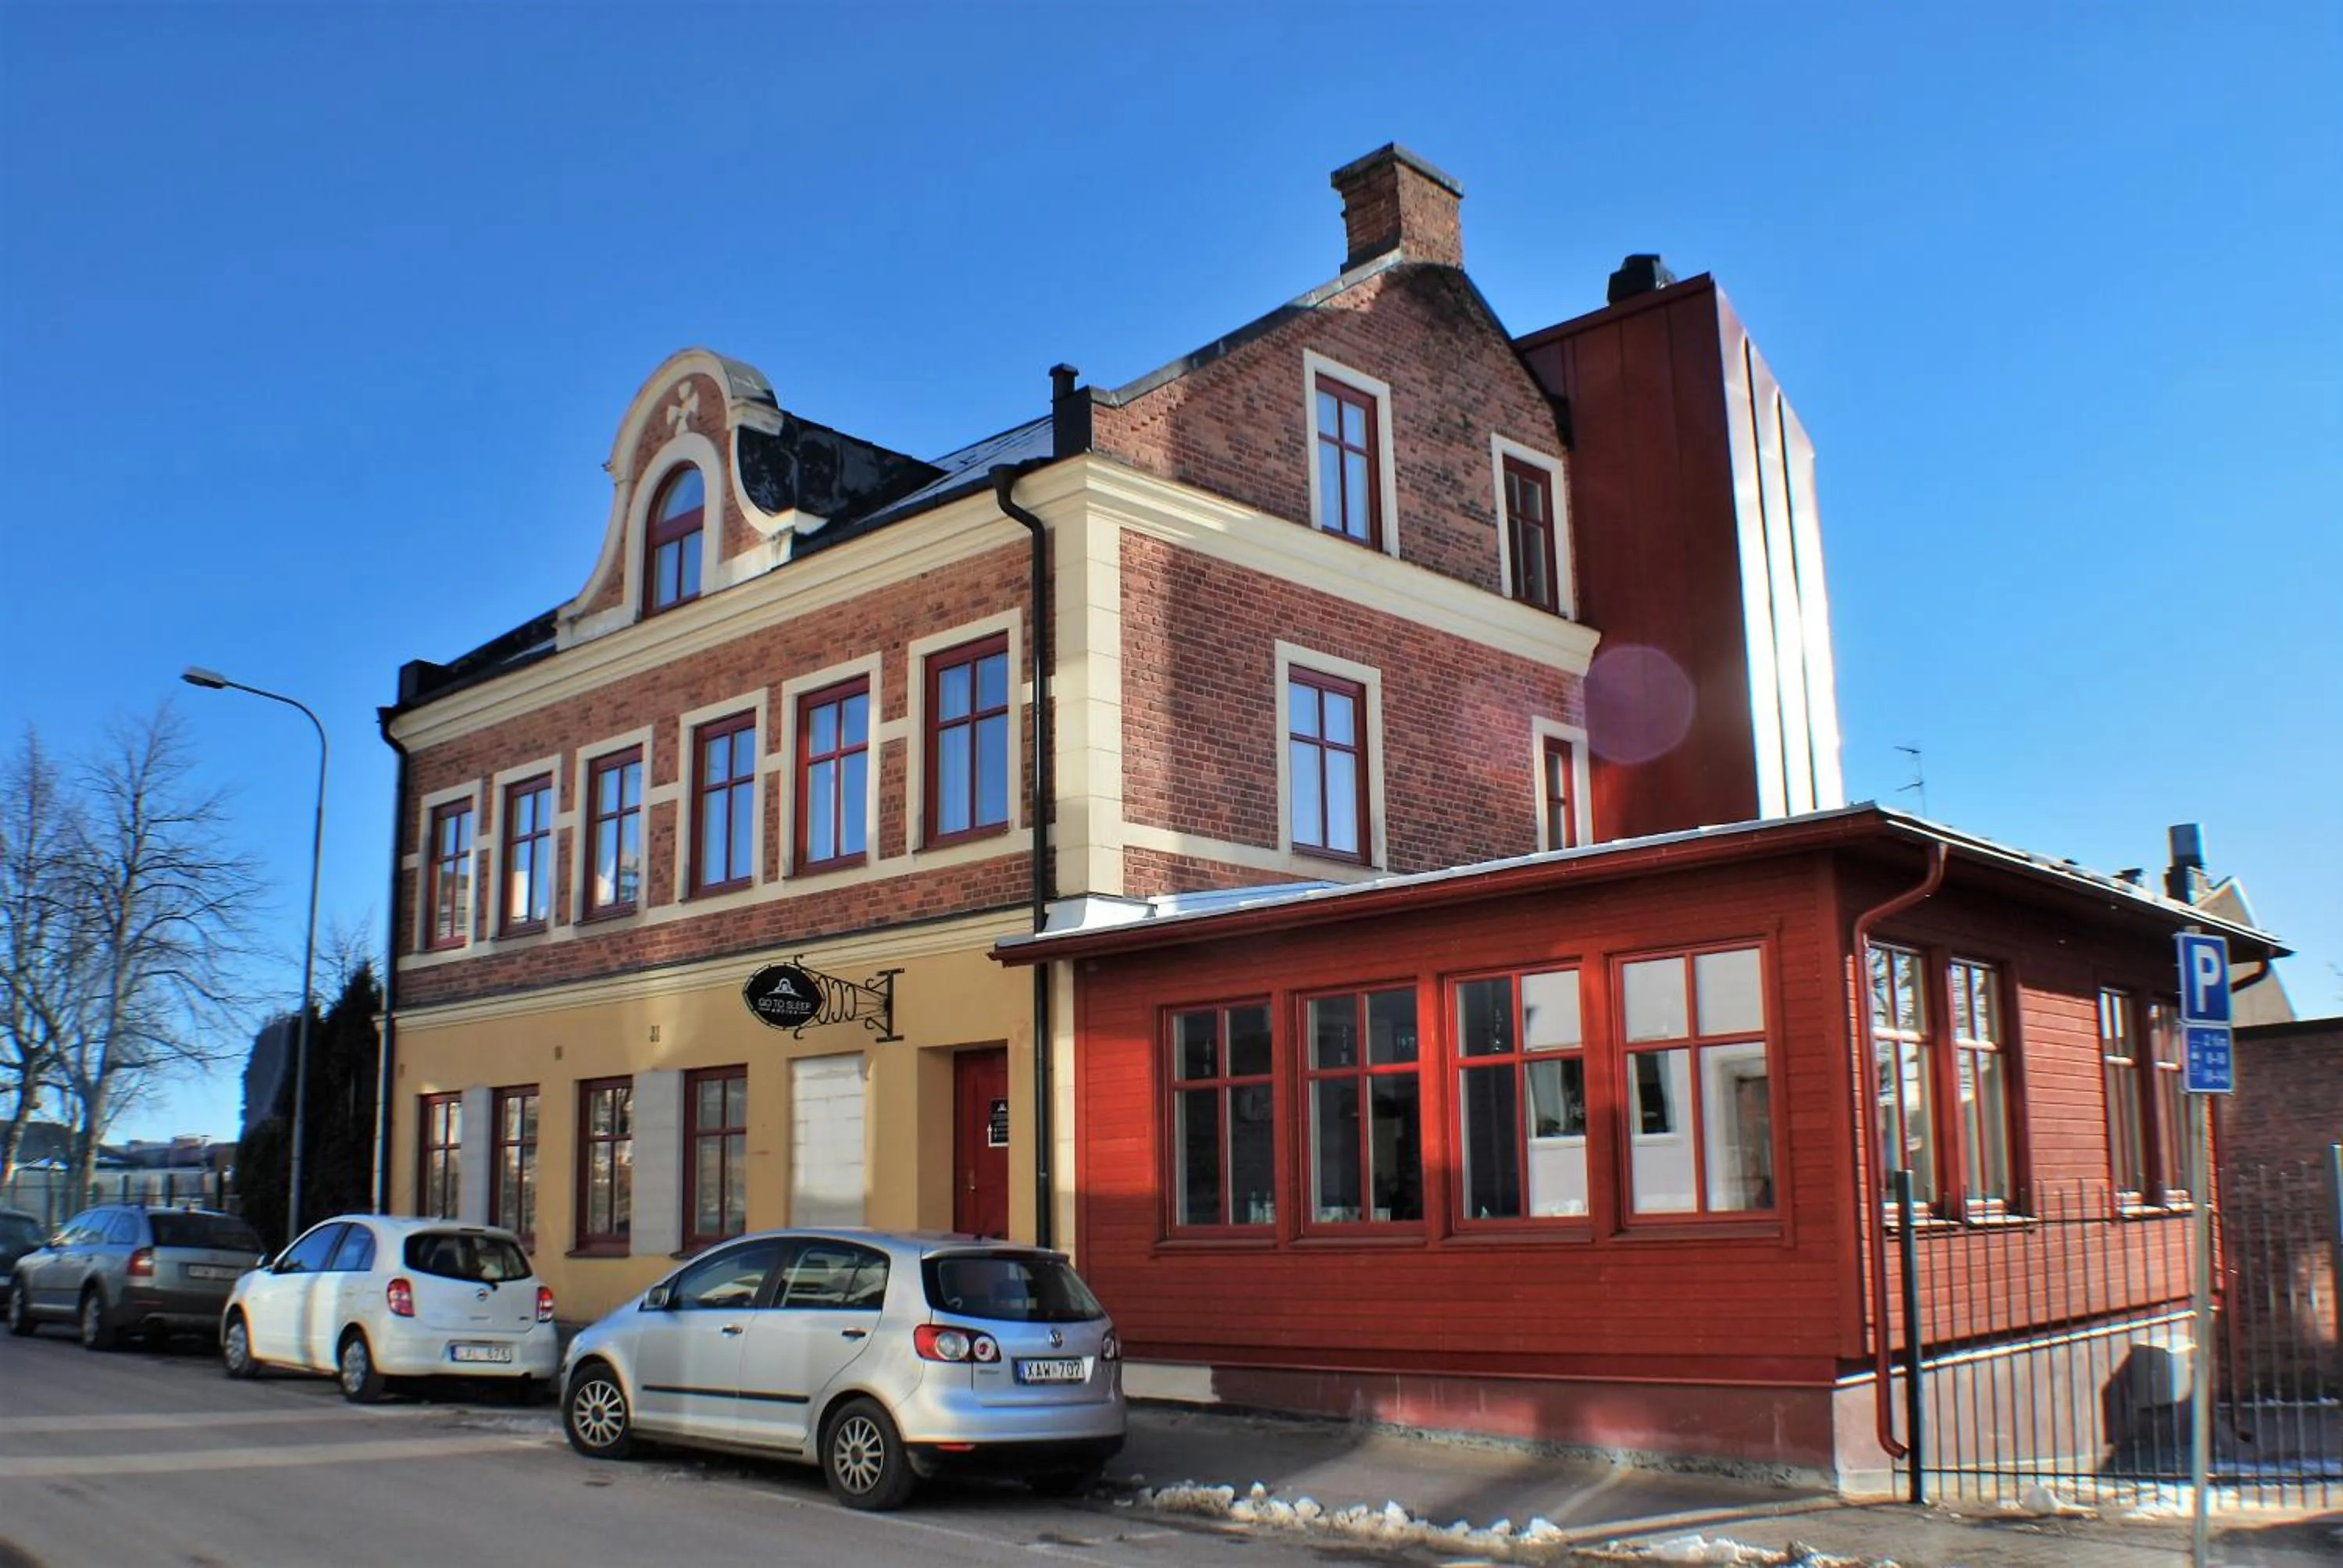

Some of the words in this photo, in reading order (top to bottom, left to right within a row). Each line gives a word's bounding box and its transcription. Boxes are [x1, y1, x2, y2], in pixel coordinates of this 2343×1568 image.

[2191, 943, 2221, 1013] P
[758, 997, 772, 1007] GO
[773, 999, 785, 1008] TO
[786, 1000, 811, 1011] SLEEP
[1027, 1361, 1050, 1377] XAW
[1058, 1360, 1081, 1377] 707
